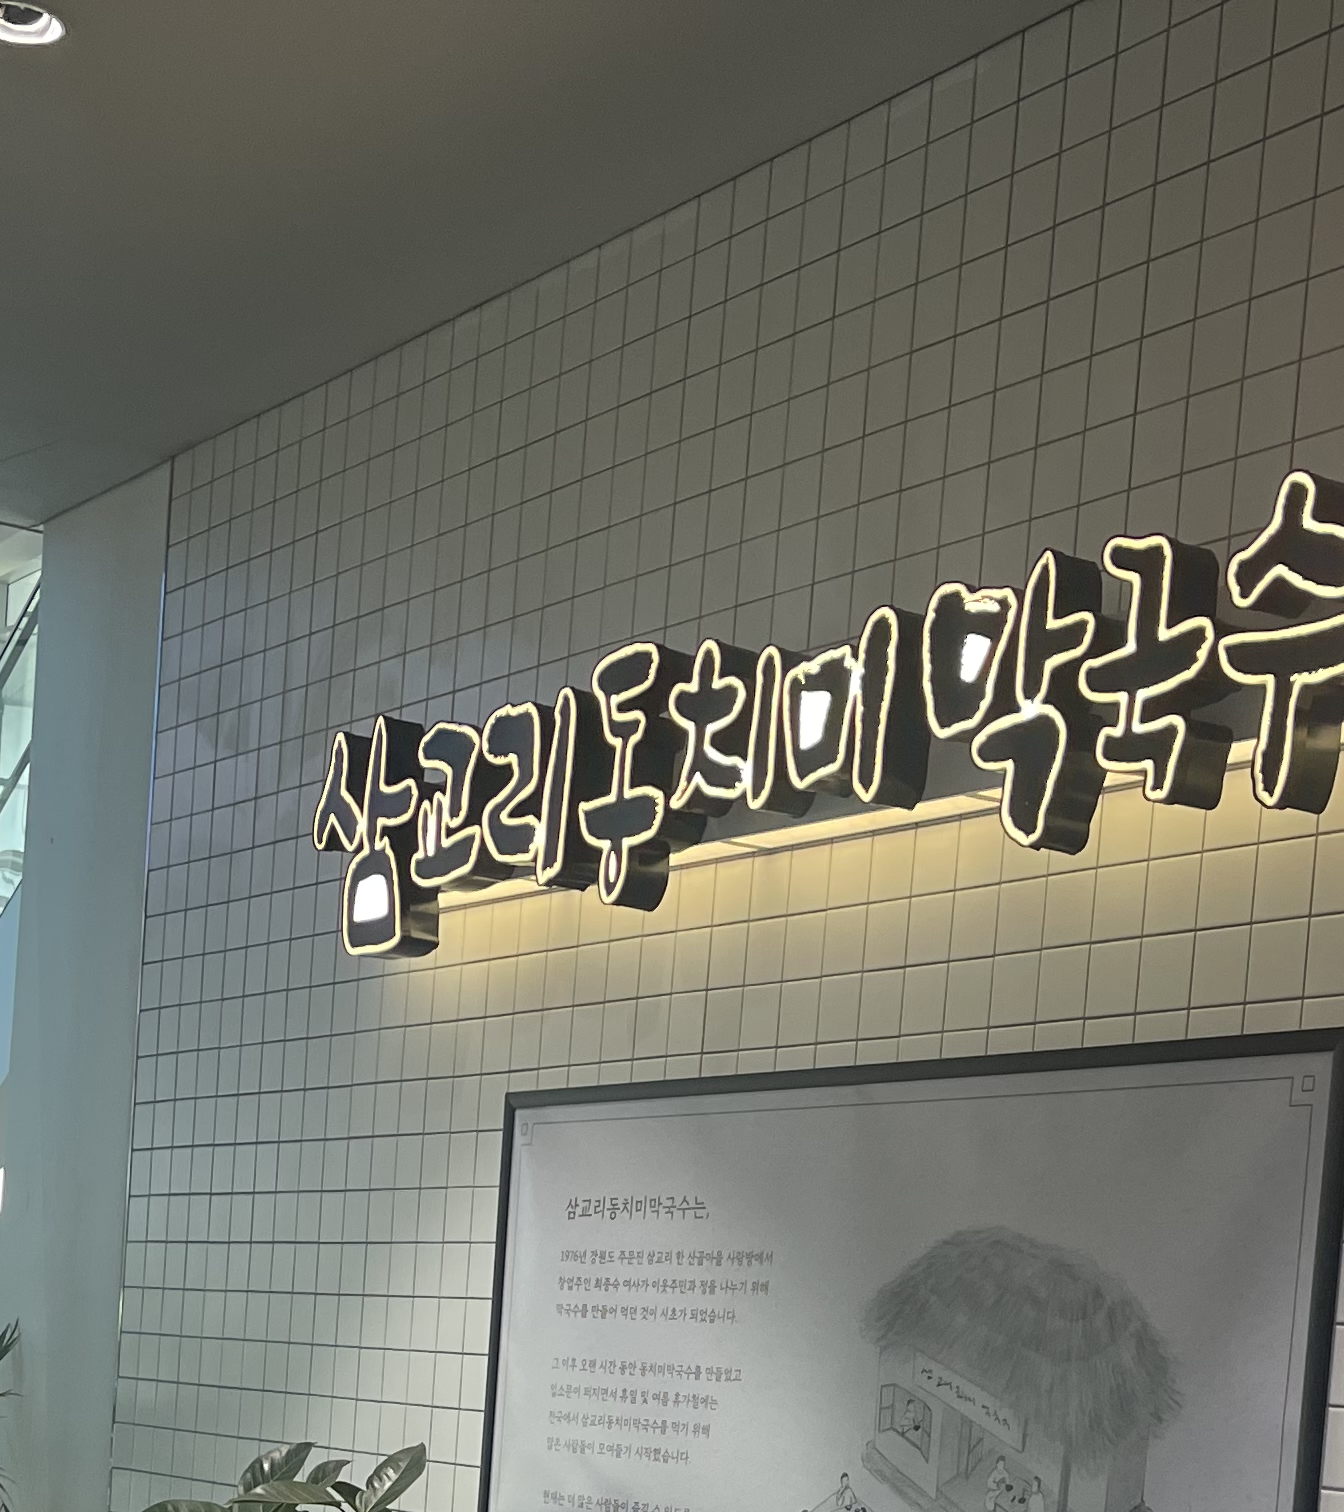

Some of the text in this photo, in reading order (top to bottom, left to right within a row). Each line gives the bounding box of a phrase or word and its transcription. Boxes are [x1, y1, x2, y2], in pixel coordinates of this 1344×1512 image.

[565, 1196, 710, 1220] 삼교리동치미막국수는,
[560, 1249, 774, 1266] 1976년 강원도 주문진 삼교리 한 산골마을 사랑방에서
[557, 1276, 592, 1291] 창업주인
[623, 1278, 649, 1292] 여사가
[651, 1278, 696, 1294] 이웃주민과
[699, 1280, 717, 1295] 정을
[719, 1279, 747, 1295] 나누기
[750, 1280, 770, 1296] 위해
[556, 1304, 589, 1318] 막국수를
[591, 1304, 617, 1319] 만들어
[620, 1305, 637, 1320] 먹던
[639, 1306, 657, 1320] 것이
[659, 1307, 687, 1322] 시초가
[551, 1357, 742, 1382] 그 이후 오랜 시간 동안 동치미막국수를 만들었고
[619, 1388, 638, 1404] 휴일
[640, 1390, 650, 1404] 및
[548, 1411, 711, 1439] 전국에서 삼교리동치미막국수를 먹기 위해
[547, 1437, 561, 1451] 많은
[563, 1439, 595, 1455] 사람들이
[596, 1443, 632, 1459] 모여들기
[567, 1494, 576, 1507] 더
[577, 1495, 593, 1510] 많은
